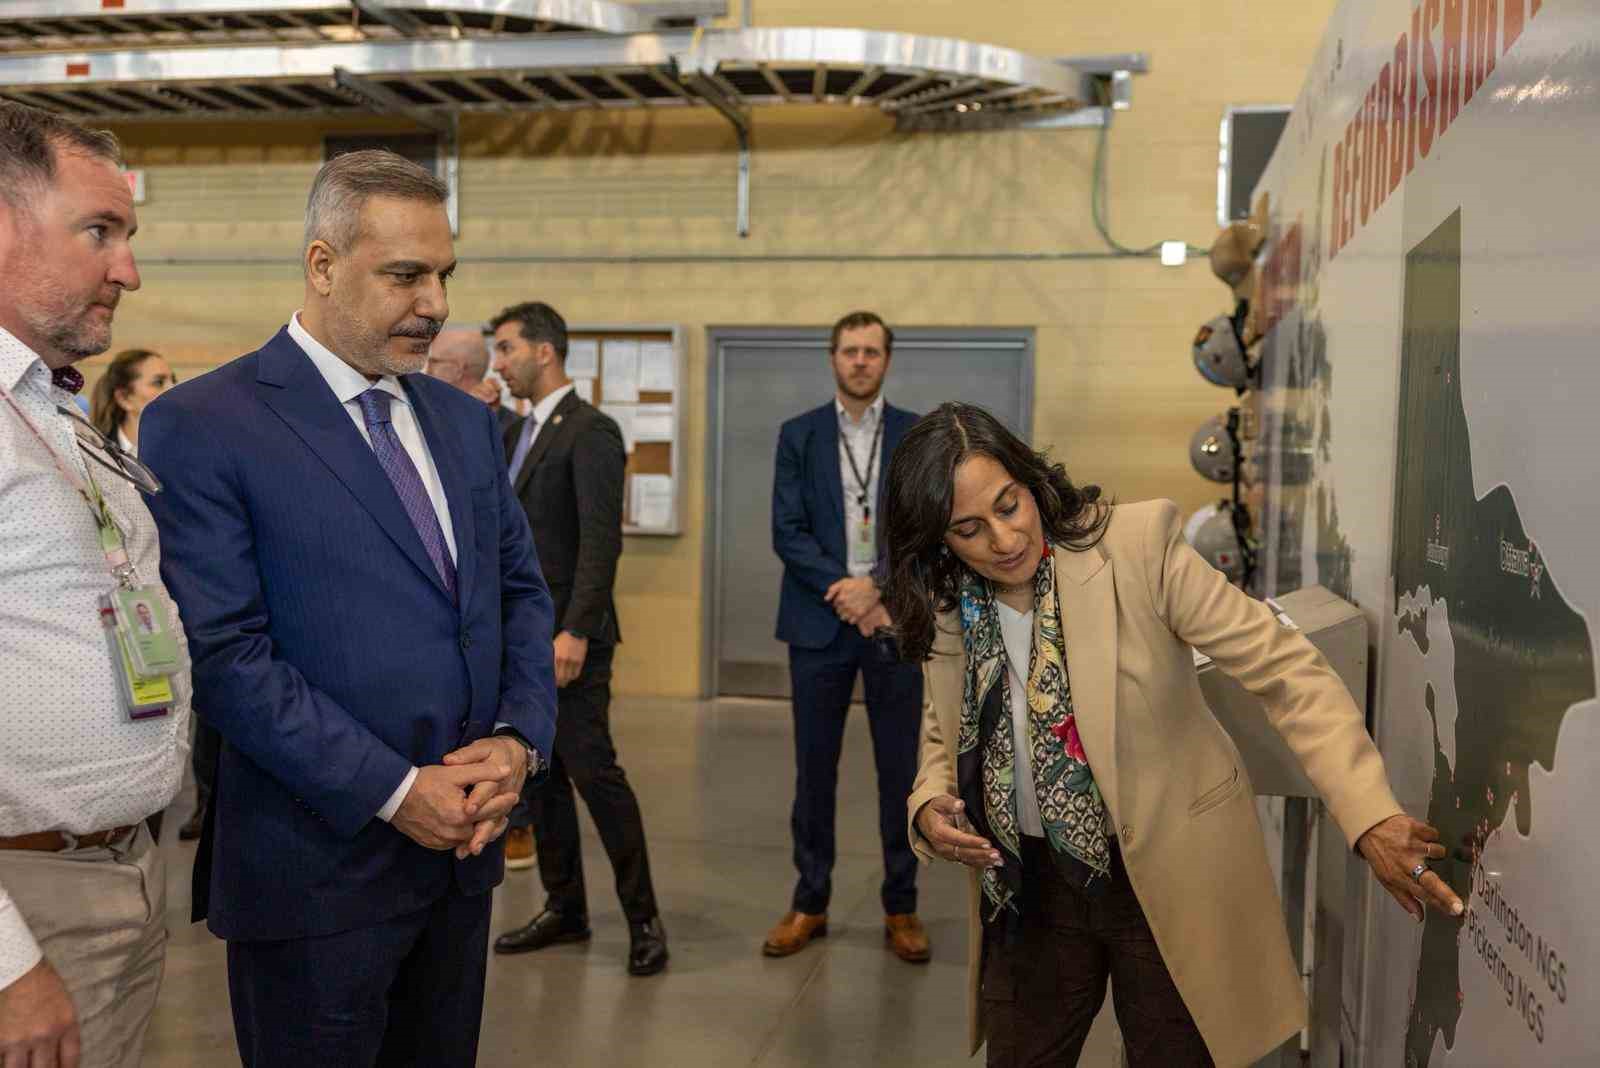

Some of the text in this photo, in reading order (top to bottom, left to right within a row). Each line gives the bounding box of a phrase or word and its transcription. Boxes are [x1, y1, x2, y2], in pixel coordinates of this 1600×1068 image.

[1329, 0, 1542, 261] REFURBISH
[1468, 908, 1544, 1044] Pickering NGS
[1476, 864, 1567, 1004] Darlington NGS
